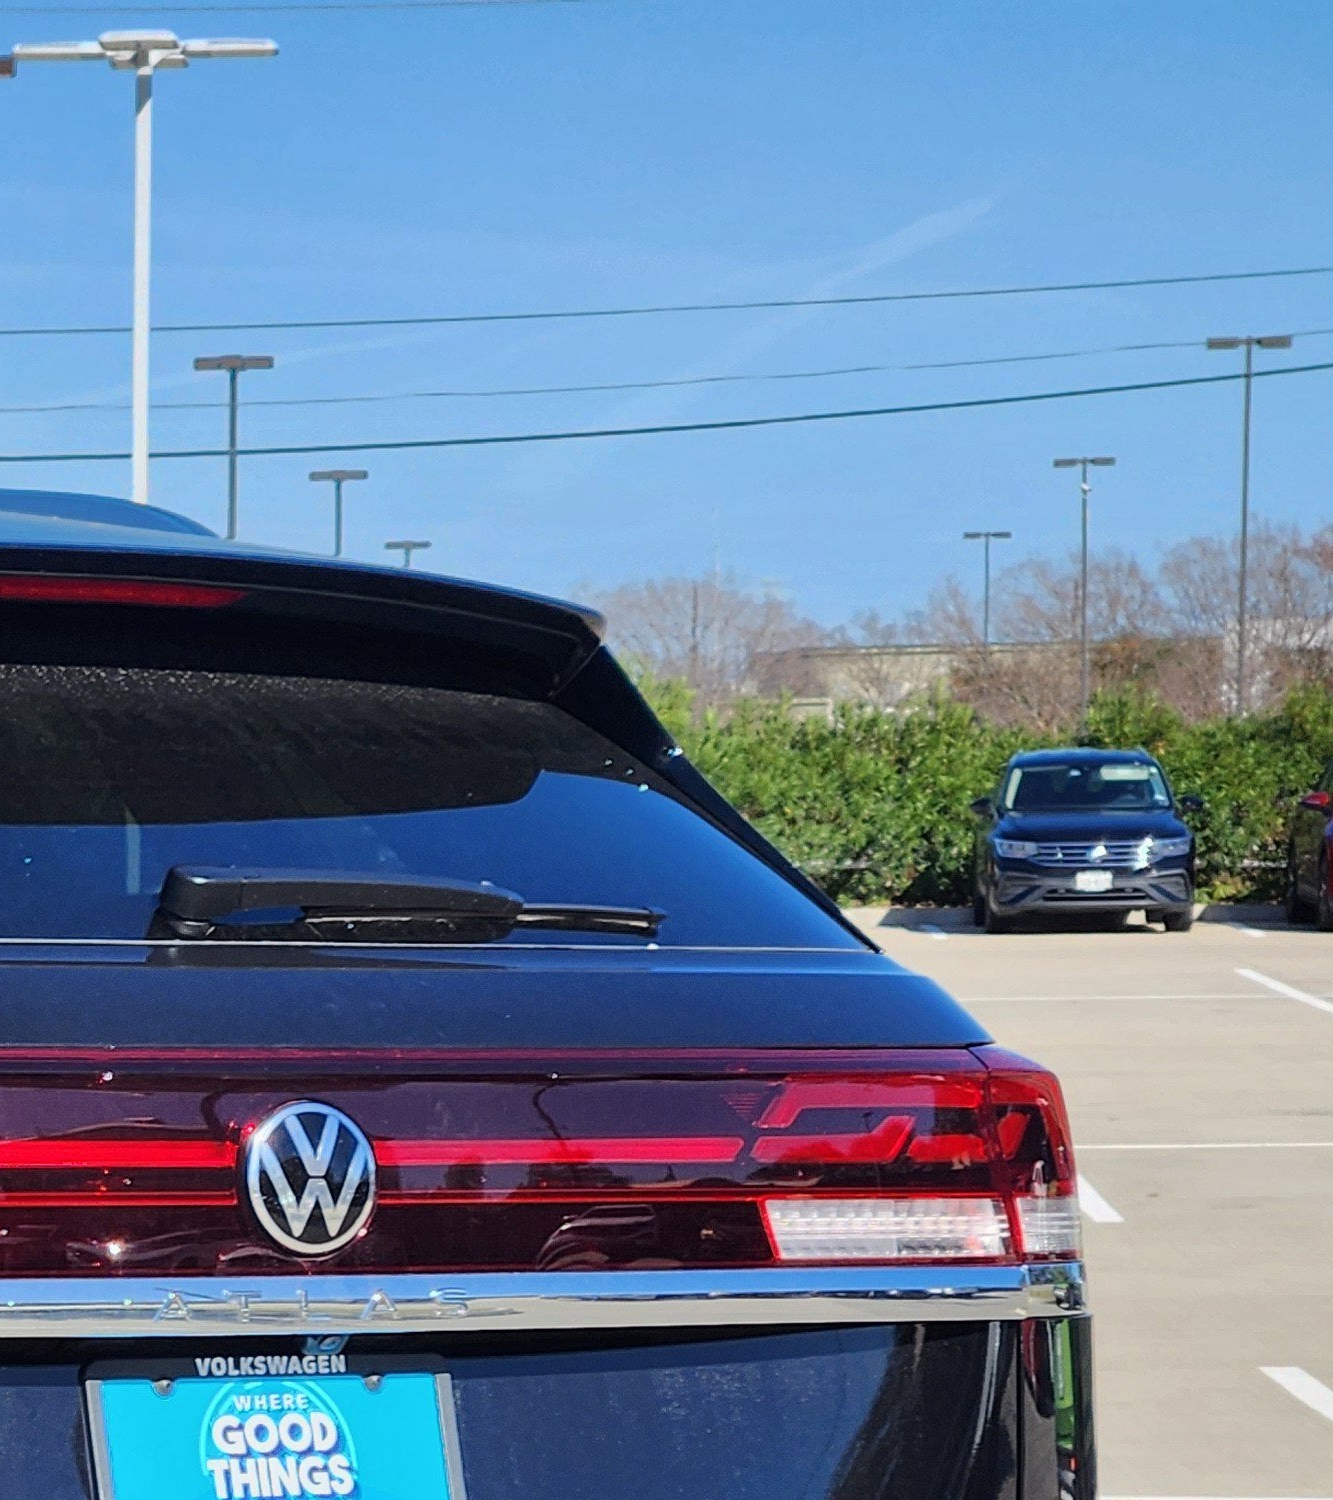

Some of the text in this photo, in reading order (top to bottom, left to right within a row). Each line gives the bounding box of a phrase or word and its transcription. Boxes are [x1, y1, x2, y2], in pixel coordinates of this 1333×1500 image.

[195, 1355, 347, 1376] VOLKSWAGEN
[233, 1392, 309, 1411] WHERE
[211, 1411, 338, 1455] GOOD
[207, 1455, 356, 1500] THINGS
